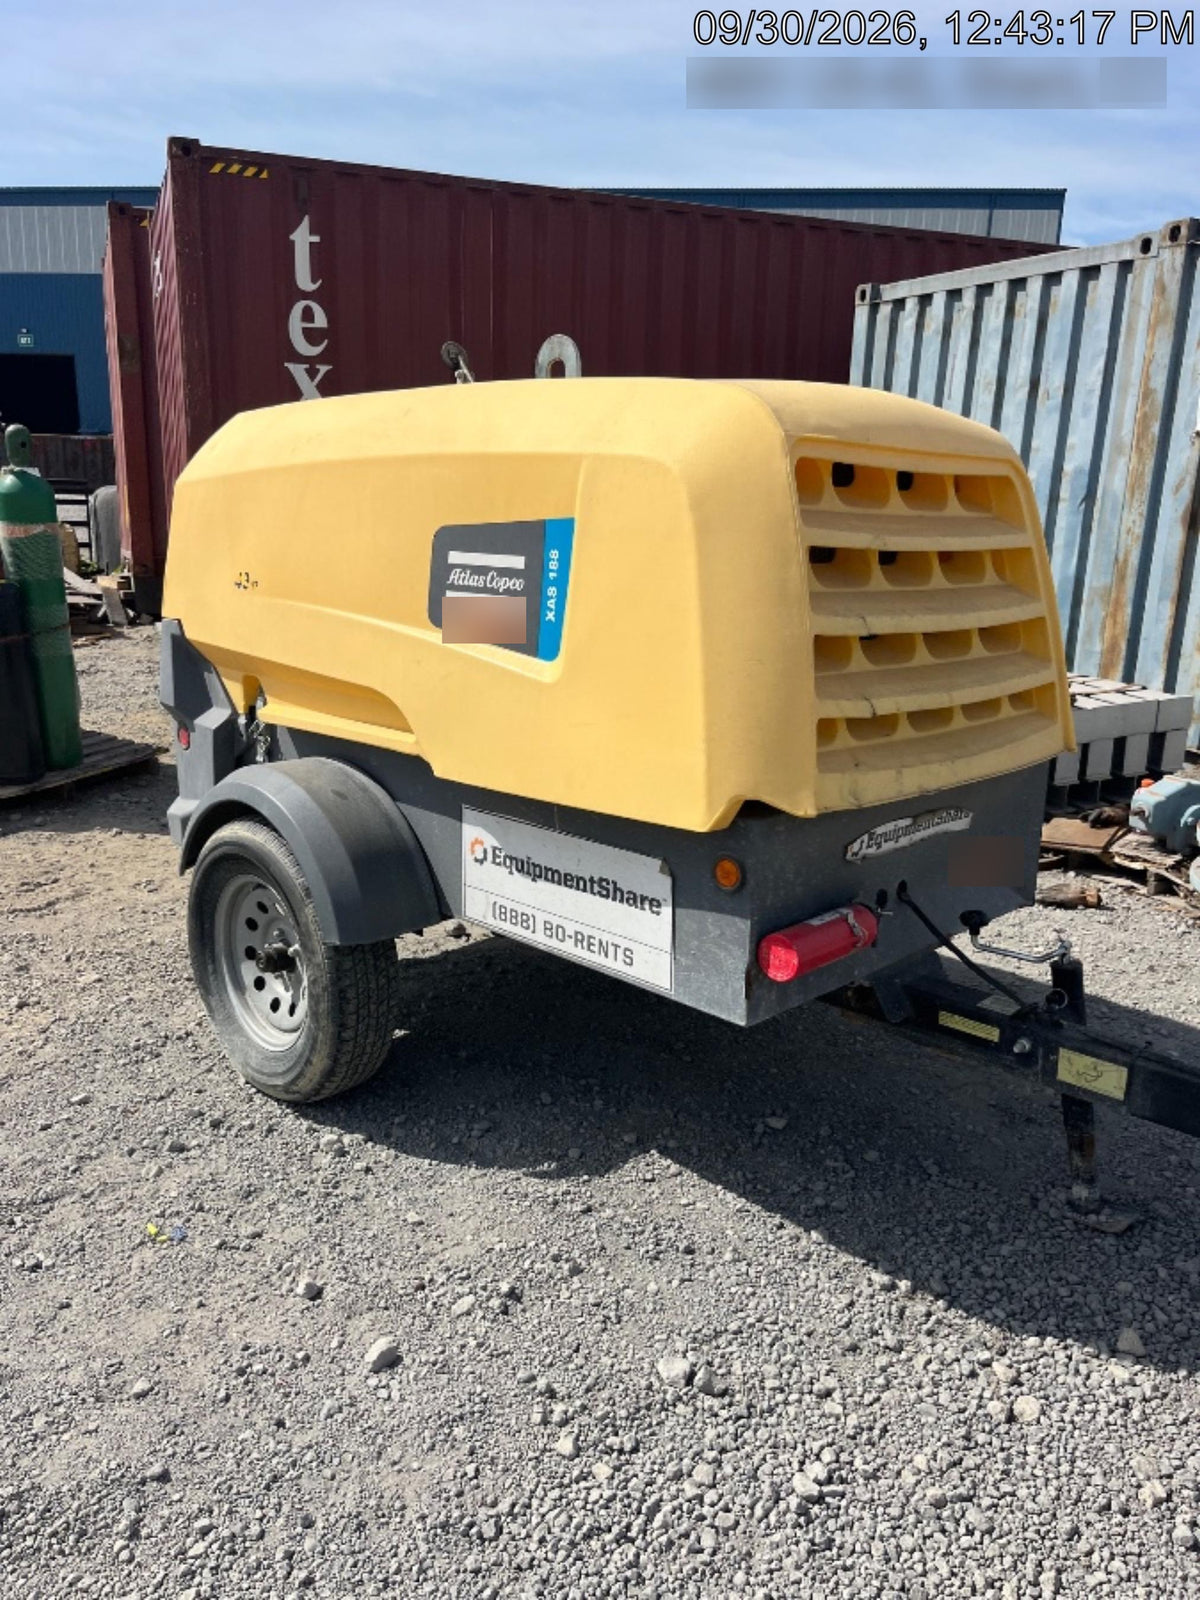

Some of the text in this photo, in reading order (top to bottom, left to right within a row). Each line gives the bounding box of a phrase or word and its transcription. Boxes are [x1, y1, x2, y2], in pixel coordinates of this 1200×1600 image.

[446, 568, 525, 592] Atlas Copco
[545, 549, 559, 622] XAS 188
[490, 845, 663, 917] EquipmentShare
[491, 900, 634, 967] (888) 80-RENTS
